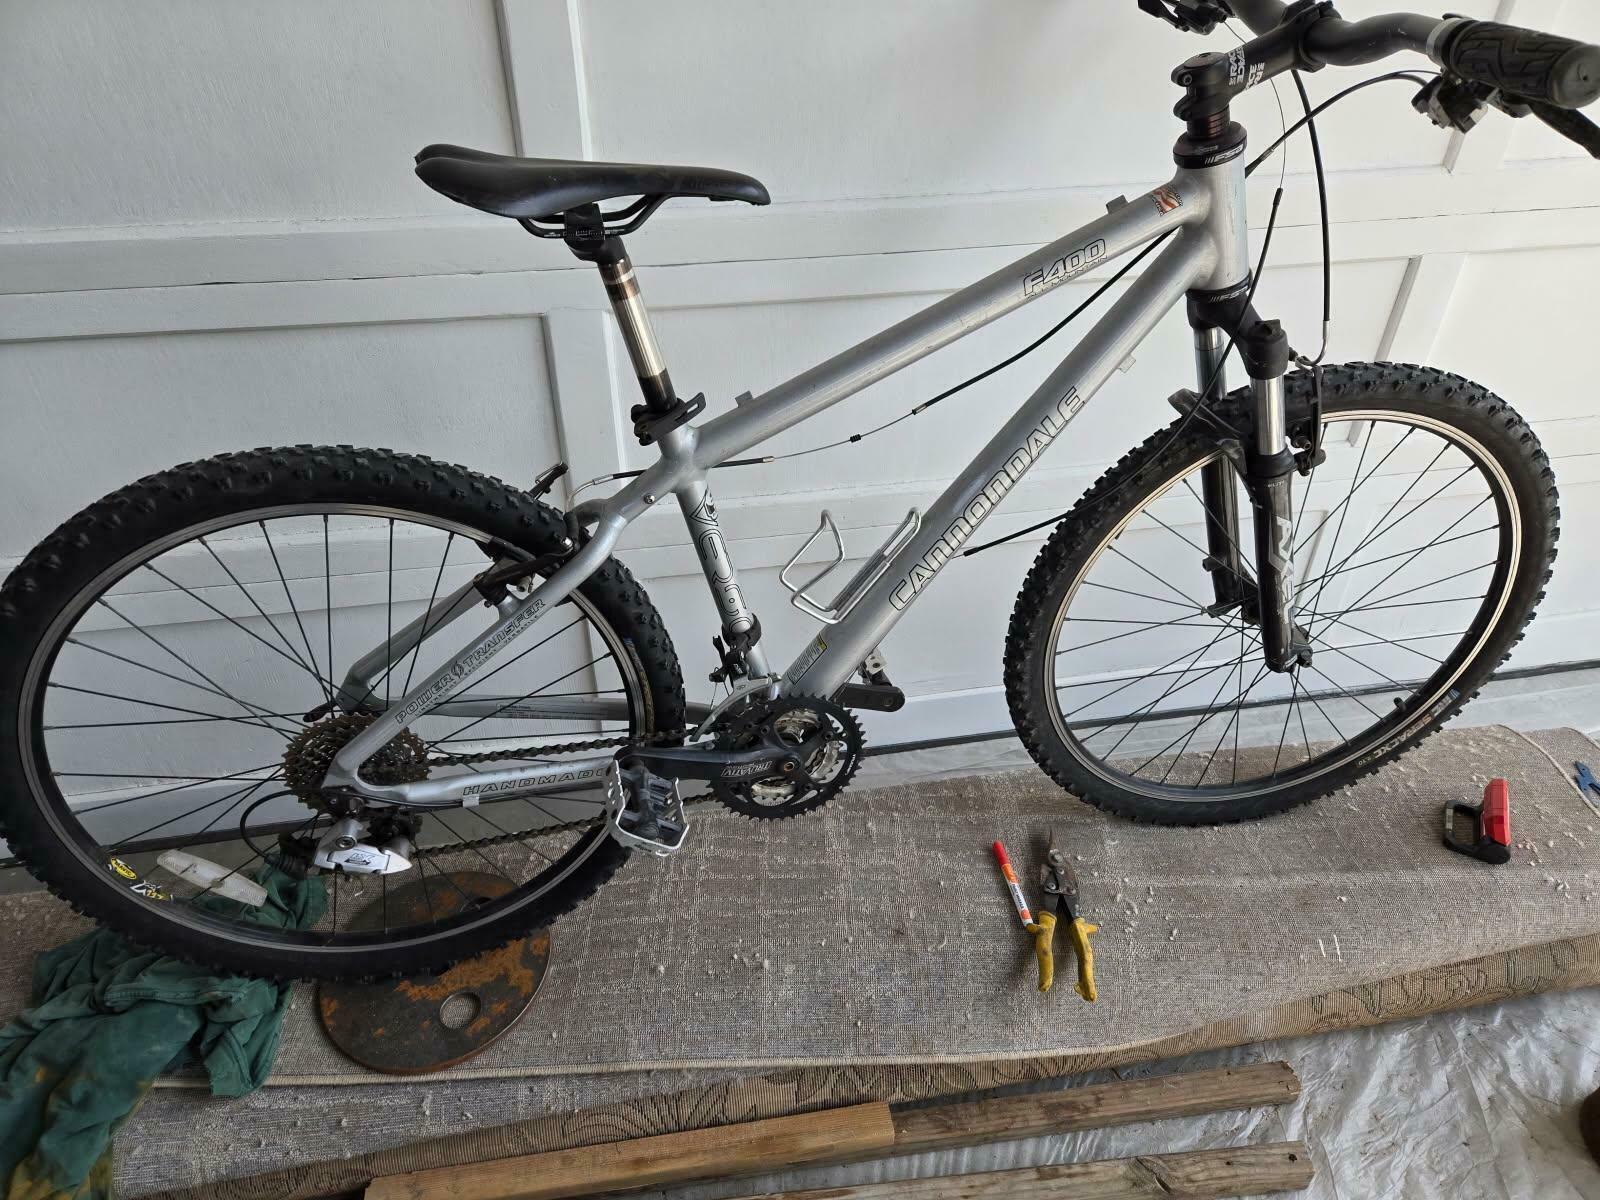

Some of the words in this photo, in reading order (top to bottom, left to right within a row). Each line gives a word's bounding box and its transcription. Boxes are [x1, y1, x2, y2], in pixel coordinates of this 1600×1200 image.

[1023, 238, 1106, 297] F400
[889, 386, 1085, 611] CANNONDALE
[394, 673, 456, 724] POWER
[463, 598, 546, 667] TRANSFER
